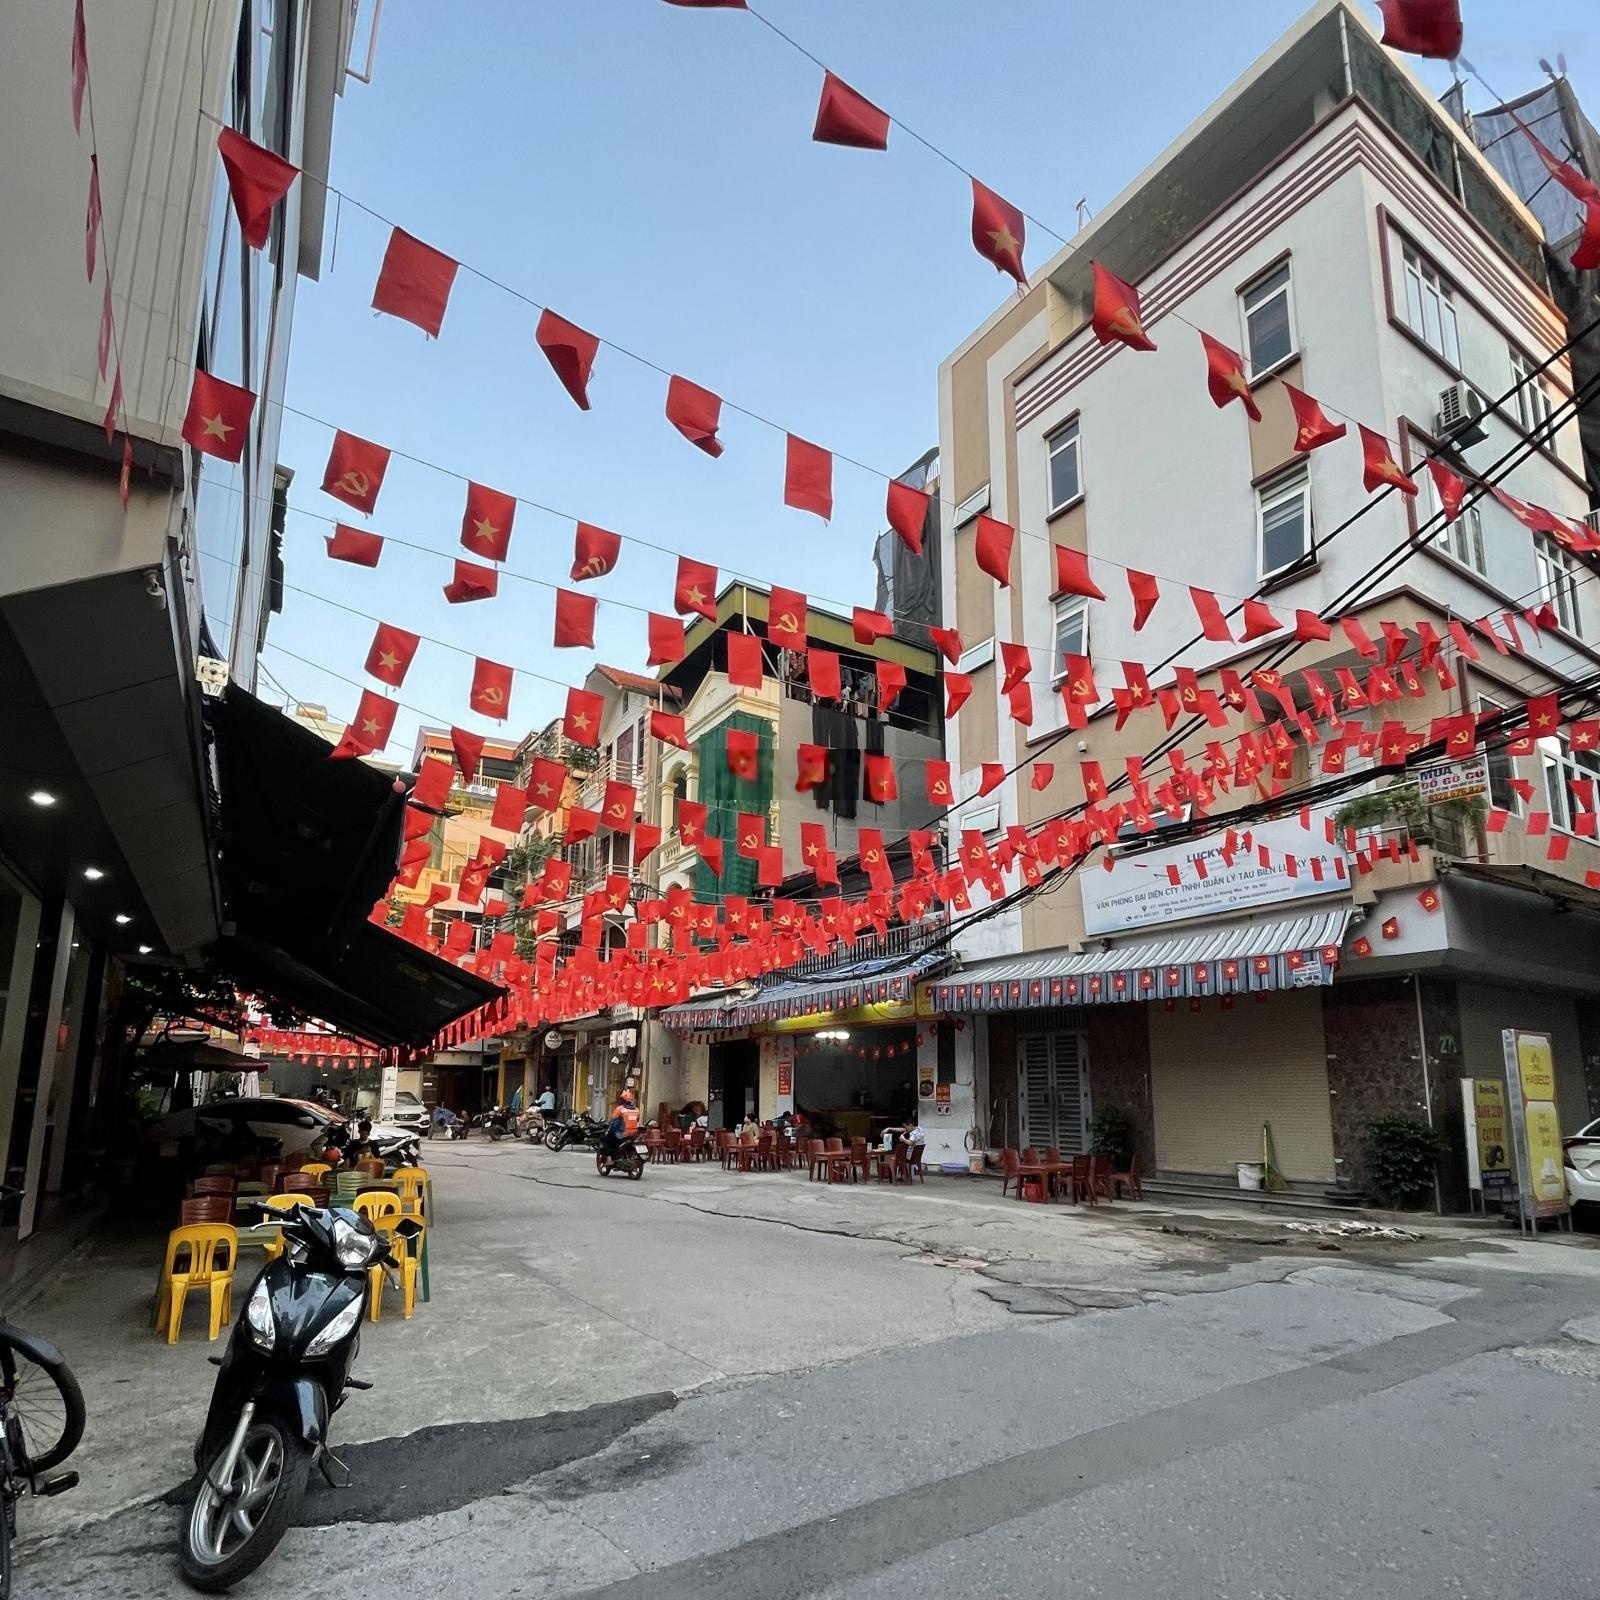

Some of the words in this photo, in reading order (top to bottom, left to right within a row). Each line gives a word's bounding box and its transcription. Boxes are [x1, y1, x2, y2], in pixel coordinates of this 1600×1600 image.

[1420, 766, 1453, 781] MUA
[1187, 846, 1223, 863] LUCKY
[1165, 886, 1179, 896] CTY
[1181, 882, 1201, 893] TNHH
